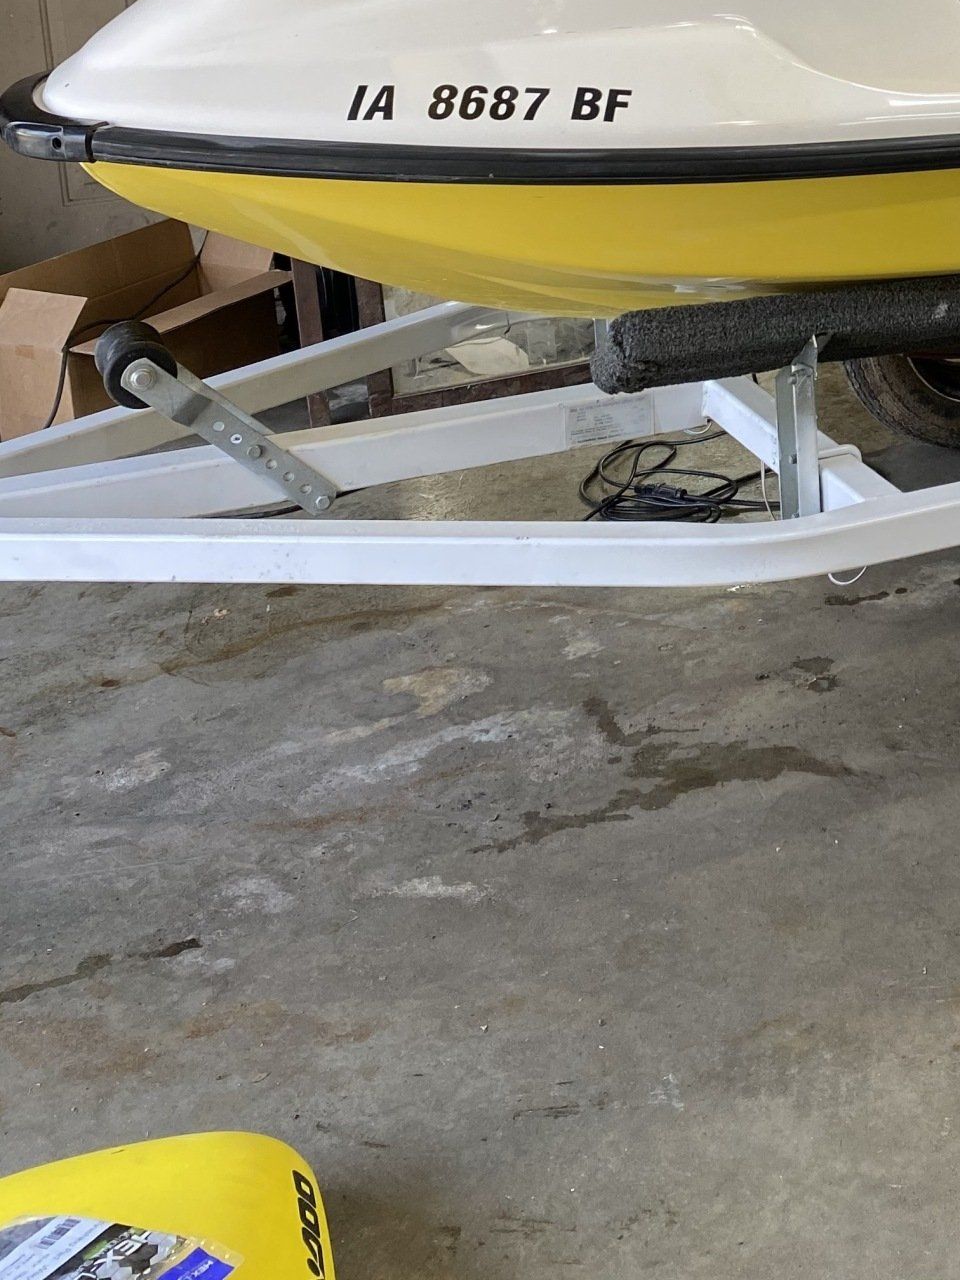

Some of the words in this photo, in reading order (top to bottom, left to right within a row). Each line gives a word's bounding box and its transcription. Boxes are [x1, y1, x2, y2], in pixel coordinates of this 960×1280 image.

[347, 85, 395, 121] IA
[427, 84, 551, 121] 8687
[571, 87, 633, 122] BF
